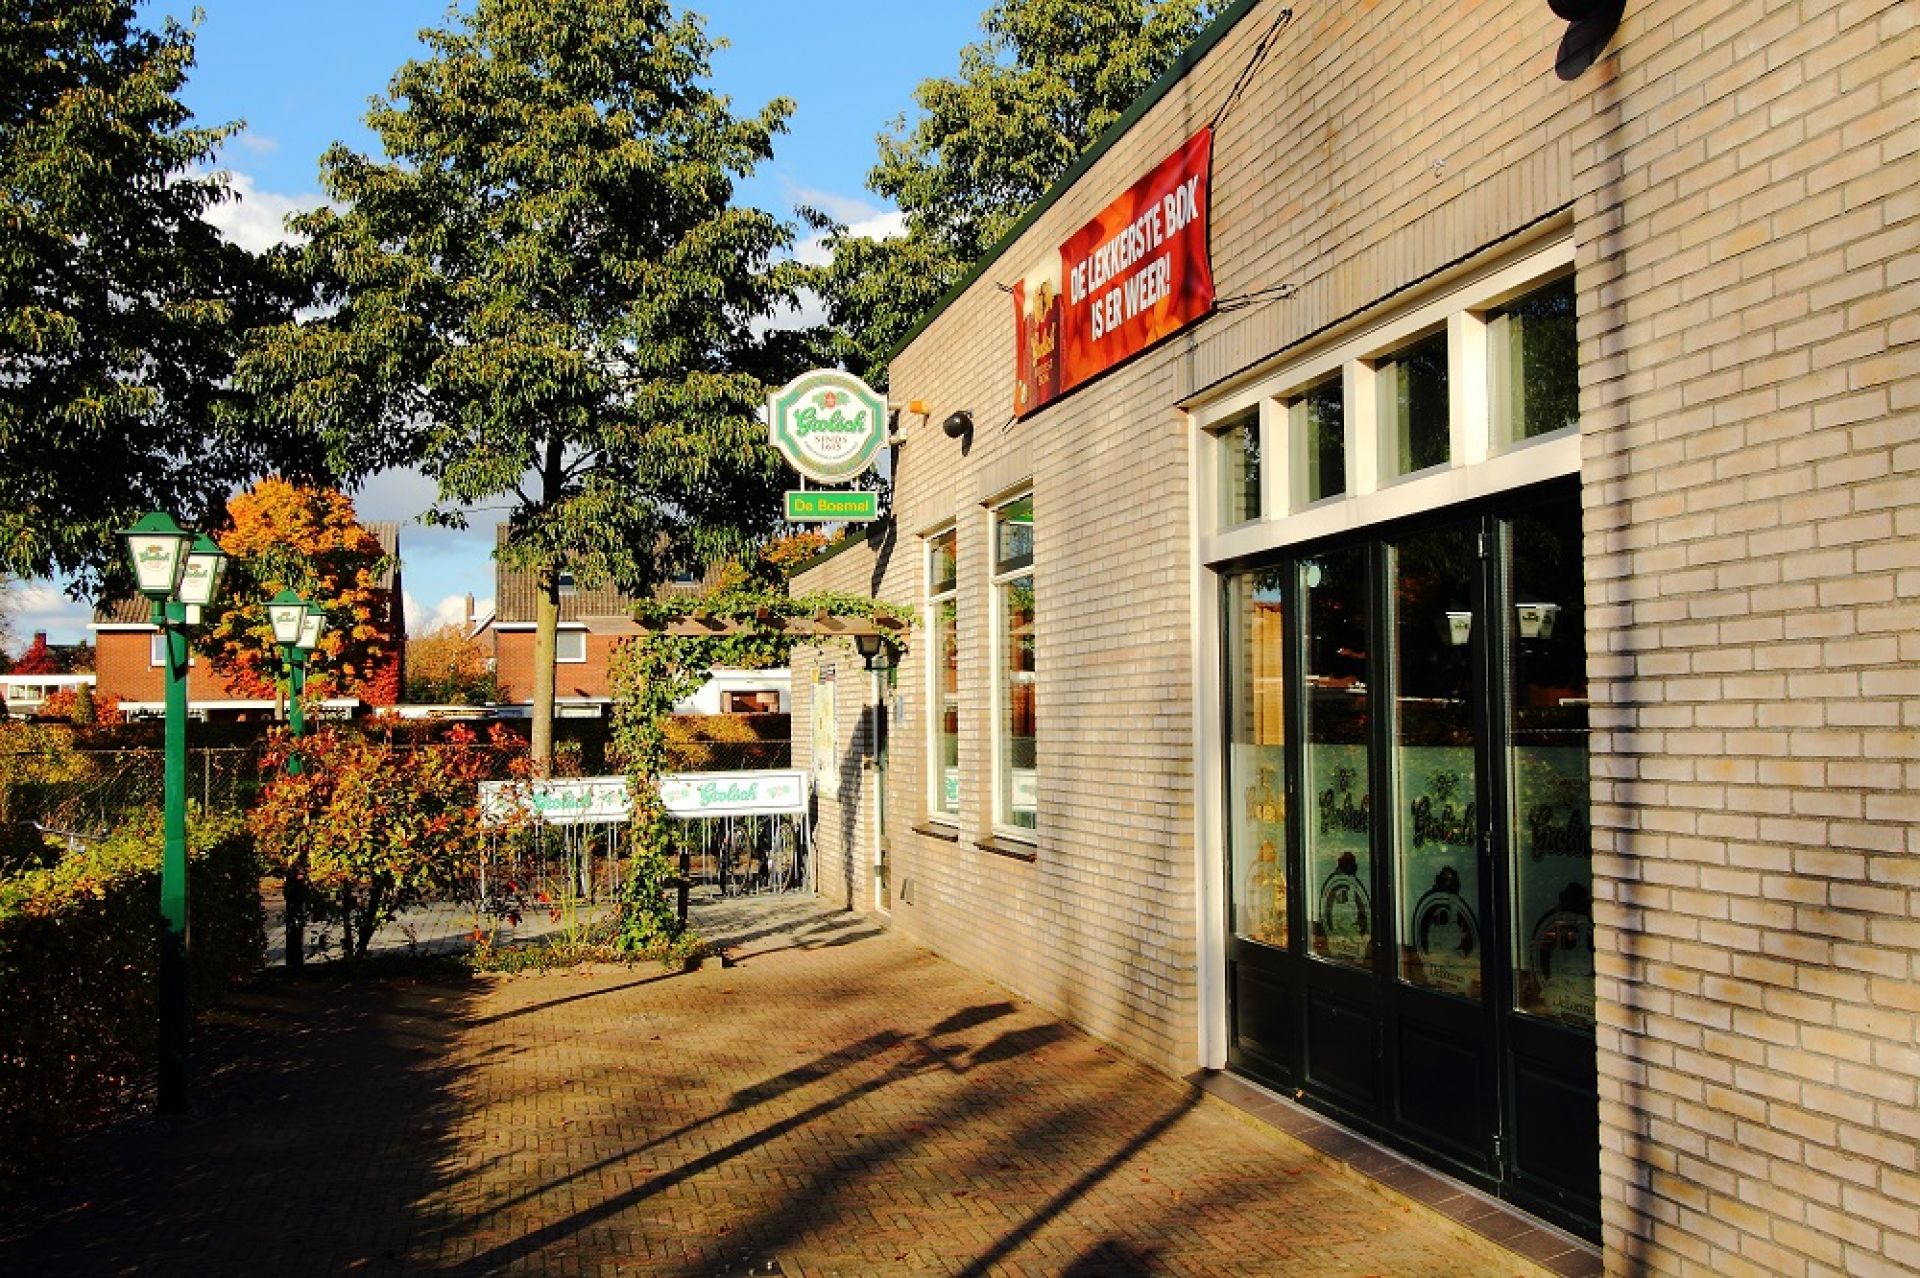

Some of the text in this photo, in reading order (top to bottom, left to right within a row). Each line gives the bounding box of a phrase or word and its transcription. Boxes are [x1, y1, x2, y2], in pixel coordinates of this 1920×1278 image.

[1070, 174, 1199, 306] DE LEKKERSTE BOK
[1091, 252, 1171, 342] IS ER WEER!
[793, 406, 866, 437] Grolsch
[815, 435, 848, 443] SINDS
[794, 499, 869, 512] De Boemel
